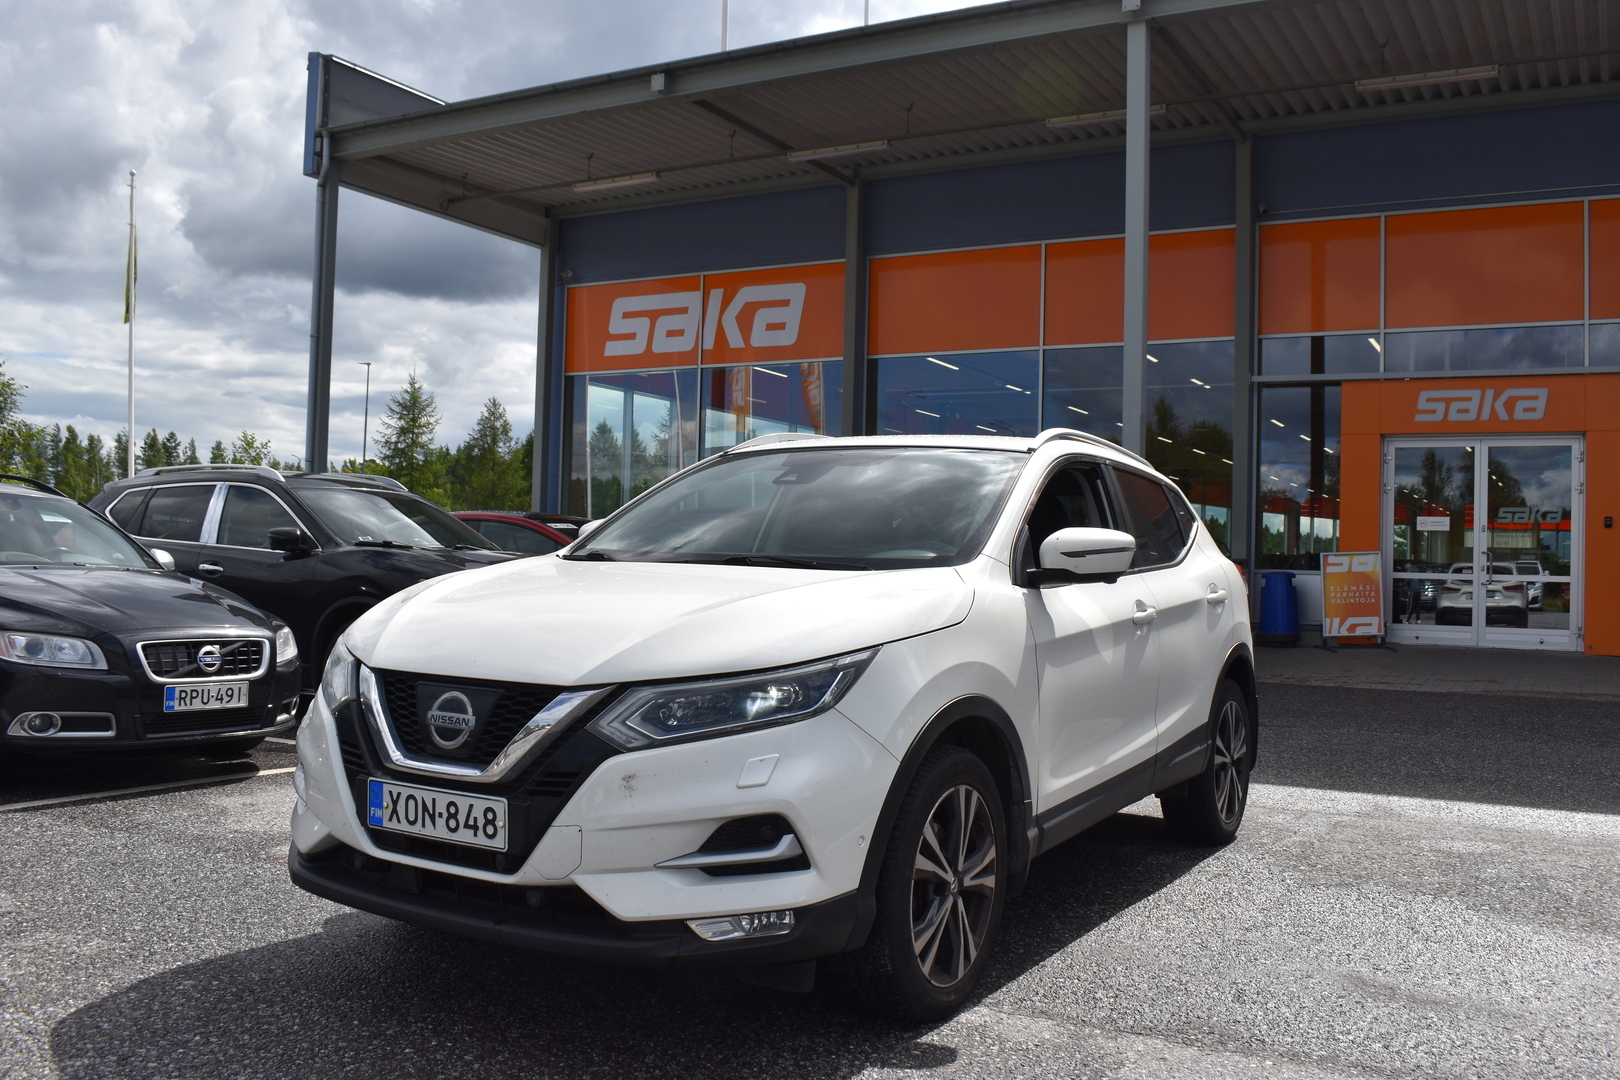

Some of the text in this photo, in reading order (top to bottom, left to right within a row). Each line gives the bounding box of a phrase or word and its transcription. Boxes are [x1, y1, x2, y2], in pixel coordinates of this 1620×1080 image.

[178, 686, 241, 706] RPU-491
[430, 714, 470, 727] NISSAN
[370, 790, 498, 839] FIN XON-848
